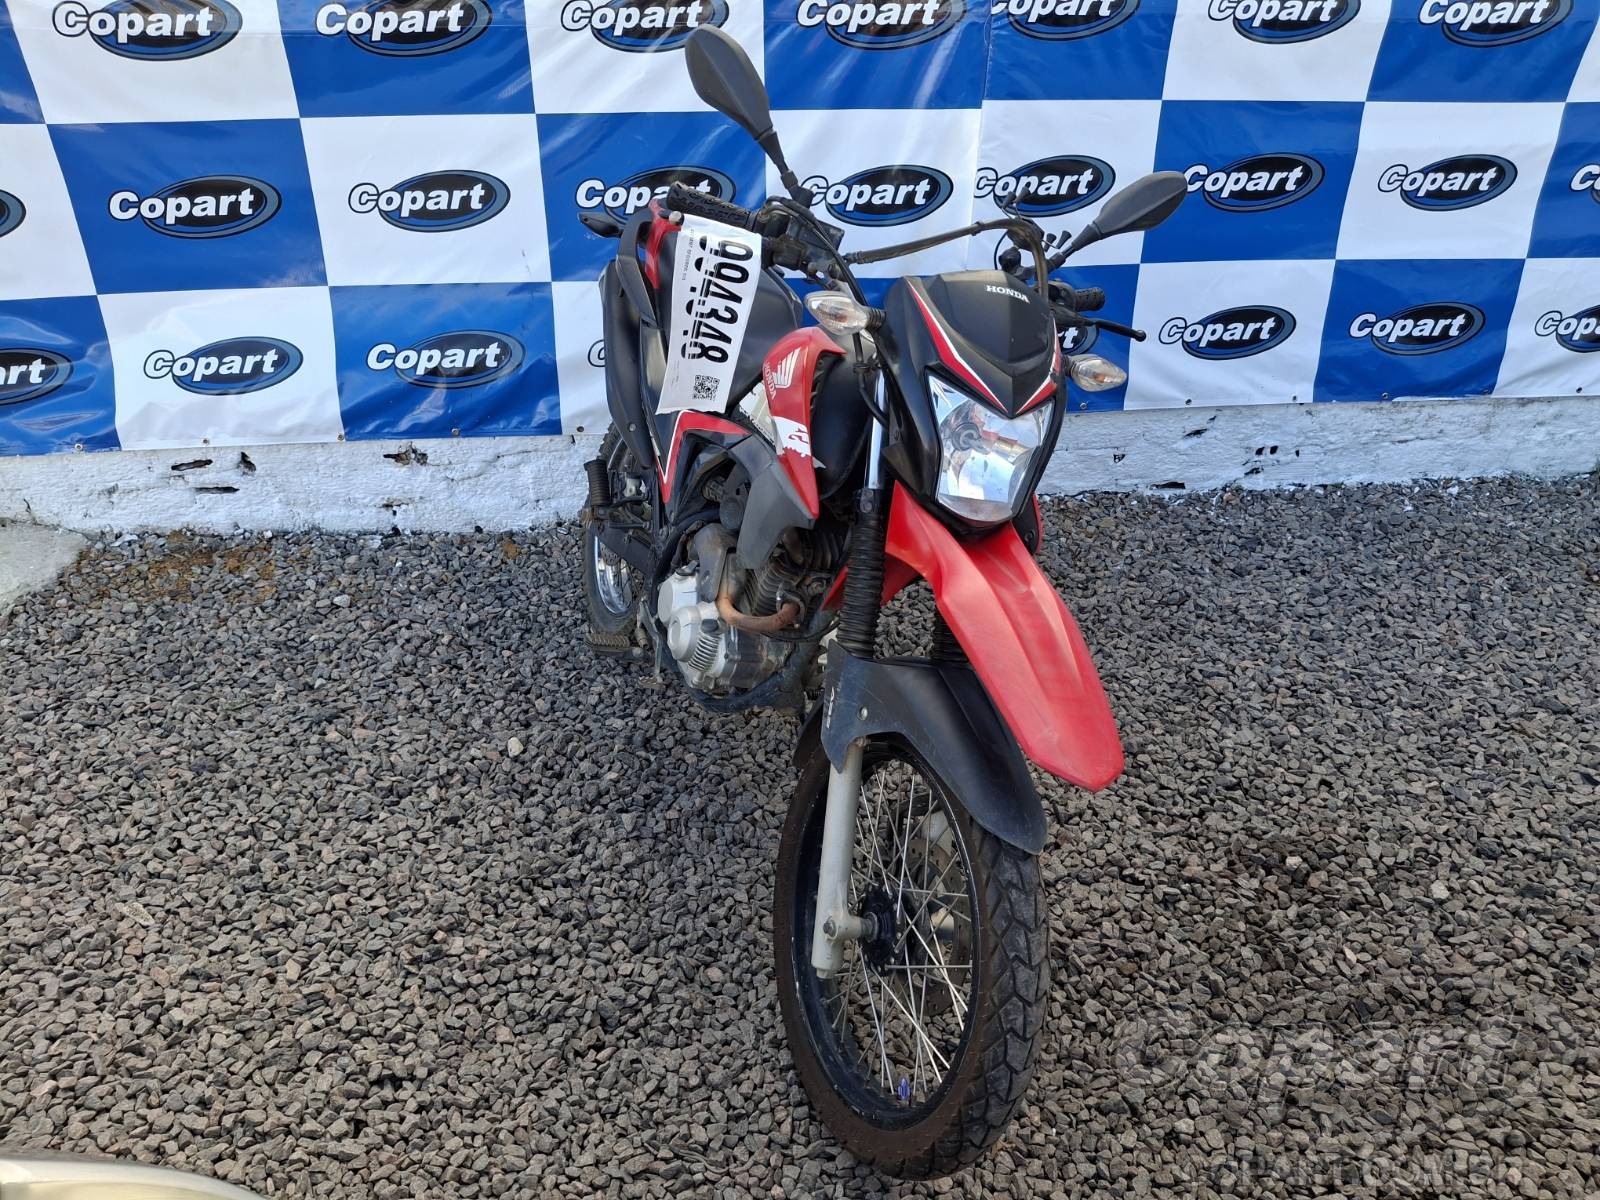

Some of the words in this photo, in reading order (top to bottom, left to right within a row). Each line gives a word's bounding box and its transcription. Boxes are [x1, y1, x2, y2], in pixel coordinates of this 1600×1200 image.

[53, 1, 214, 43] Copart
[315, 3, 464, 41] Copart
[561, 0, 704, 34] Copart
[797, 0, 939, 33] Copart
[1208, 0, 1334, 28] Copart
[1419, 0, 1544, 31] Copart
[801, 175, 930, 211] Copart
[974, 167, 1093, 200] Copart
[1183, 164, 1304, 196] Copart
[1378, 164, 1497, 196] Copart
[109, 188, 255, 224] Copart
[348, 183, 485, 220] Copart
[986, 284, 1031, 304] HONDA
[1159, 317, 1276, 346] Copart
[1349, 312, 1466, 339] Copart
[144, 349, 279, 378] Copart
[366, 341, 501, 373] Copart
[763, 360, 777, 400] HONDA
